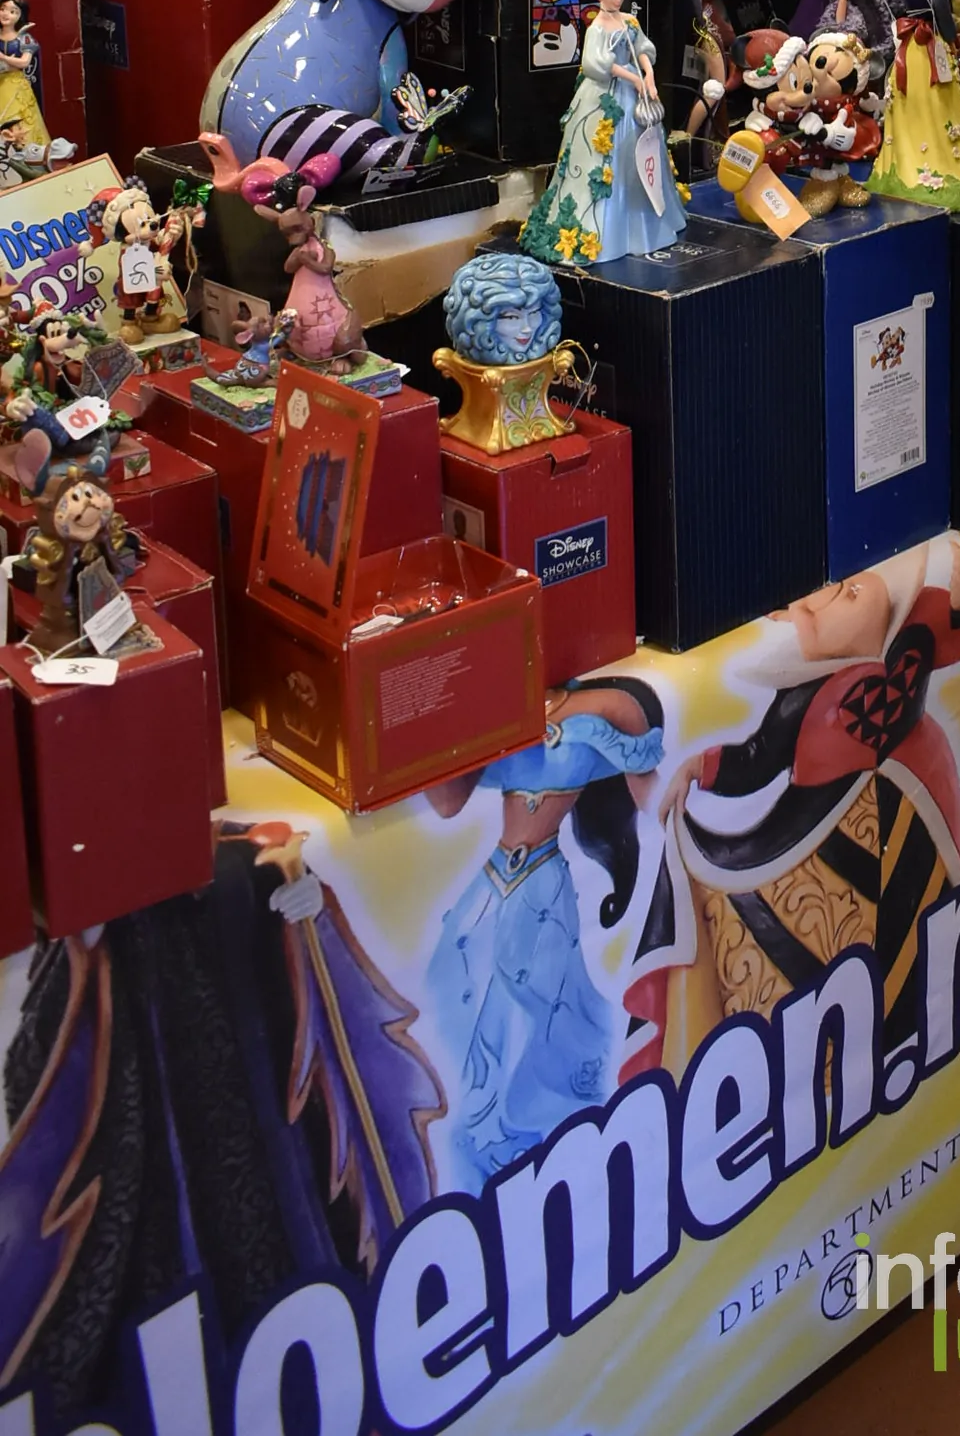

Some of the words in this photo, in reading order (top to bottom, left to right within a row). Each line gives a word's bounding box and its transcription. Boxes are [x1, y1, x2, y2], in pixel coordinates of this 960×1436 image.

[644, 155, 655, 187] 80
[547, 536, 595, 559] Disney
[542, 549, 602, 578] SHOWCASE
[65, 663, 97, 675] 35
